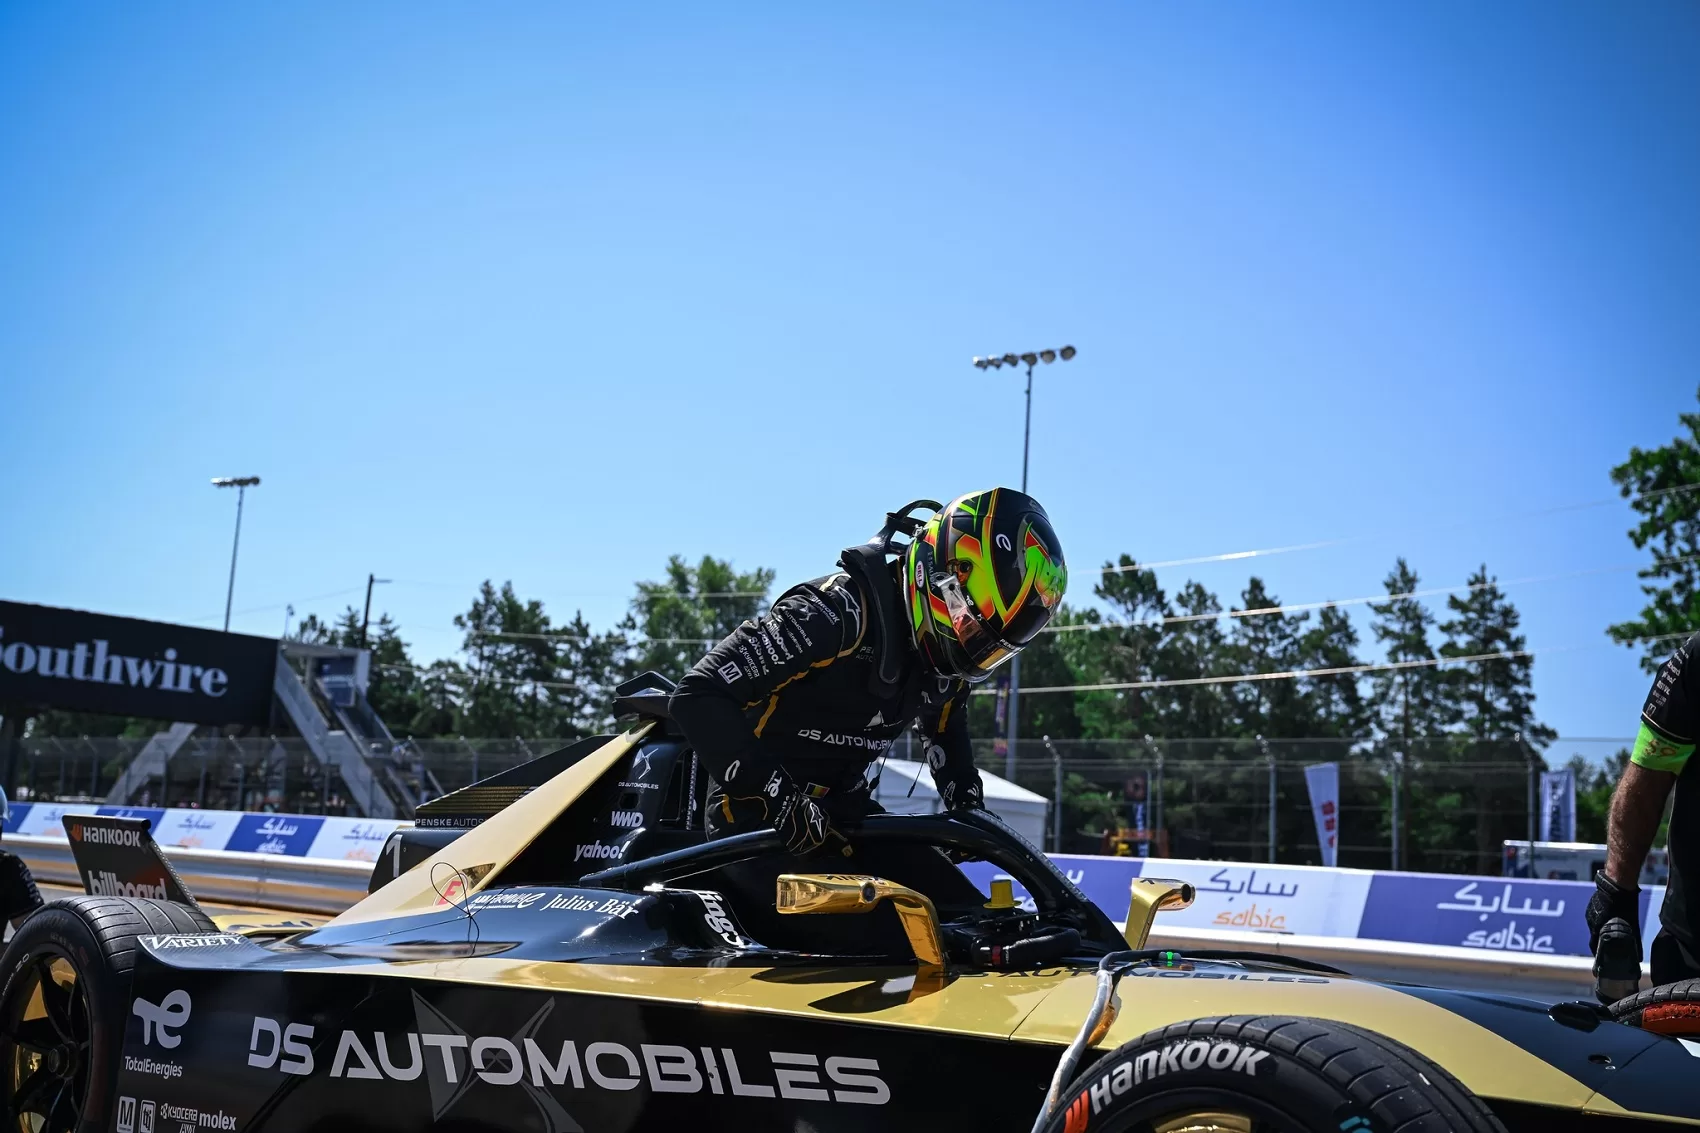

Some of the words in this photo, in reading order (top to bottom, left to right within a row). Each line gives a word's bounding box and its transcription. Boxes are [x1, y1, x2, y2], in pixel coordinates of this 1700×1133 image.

[0, 639, 228, 697] outhwire
[797, 729, 822, 741] DS
[415, 818, 452, 827] PENSKE
[453, 818, 485, 827] AUTOS
[611, 810, 644, 828] WWD
[385, 834, 403, 878] 1
[574, 840, 632, 862] yahoo!
[1195, 868, 1299, 902] سابك
[540, 893, 597, 911] Julius
[595, 898, 639, 920] Bär
[1436, 882, 1566, 922] سابك
[1212, 903, 1287, 929] sabic
[144, 936, 242, 950] VARIETY
[1461, 920, 1555, 953] sabic
[124, 1056, 183, 1080] TotalEnergies
[248, 1016, 315, 1076] DS
[329, 1029, 891, 1105] AUTOMOBILES
[198, 1110, 237, 1131] molex
